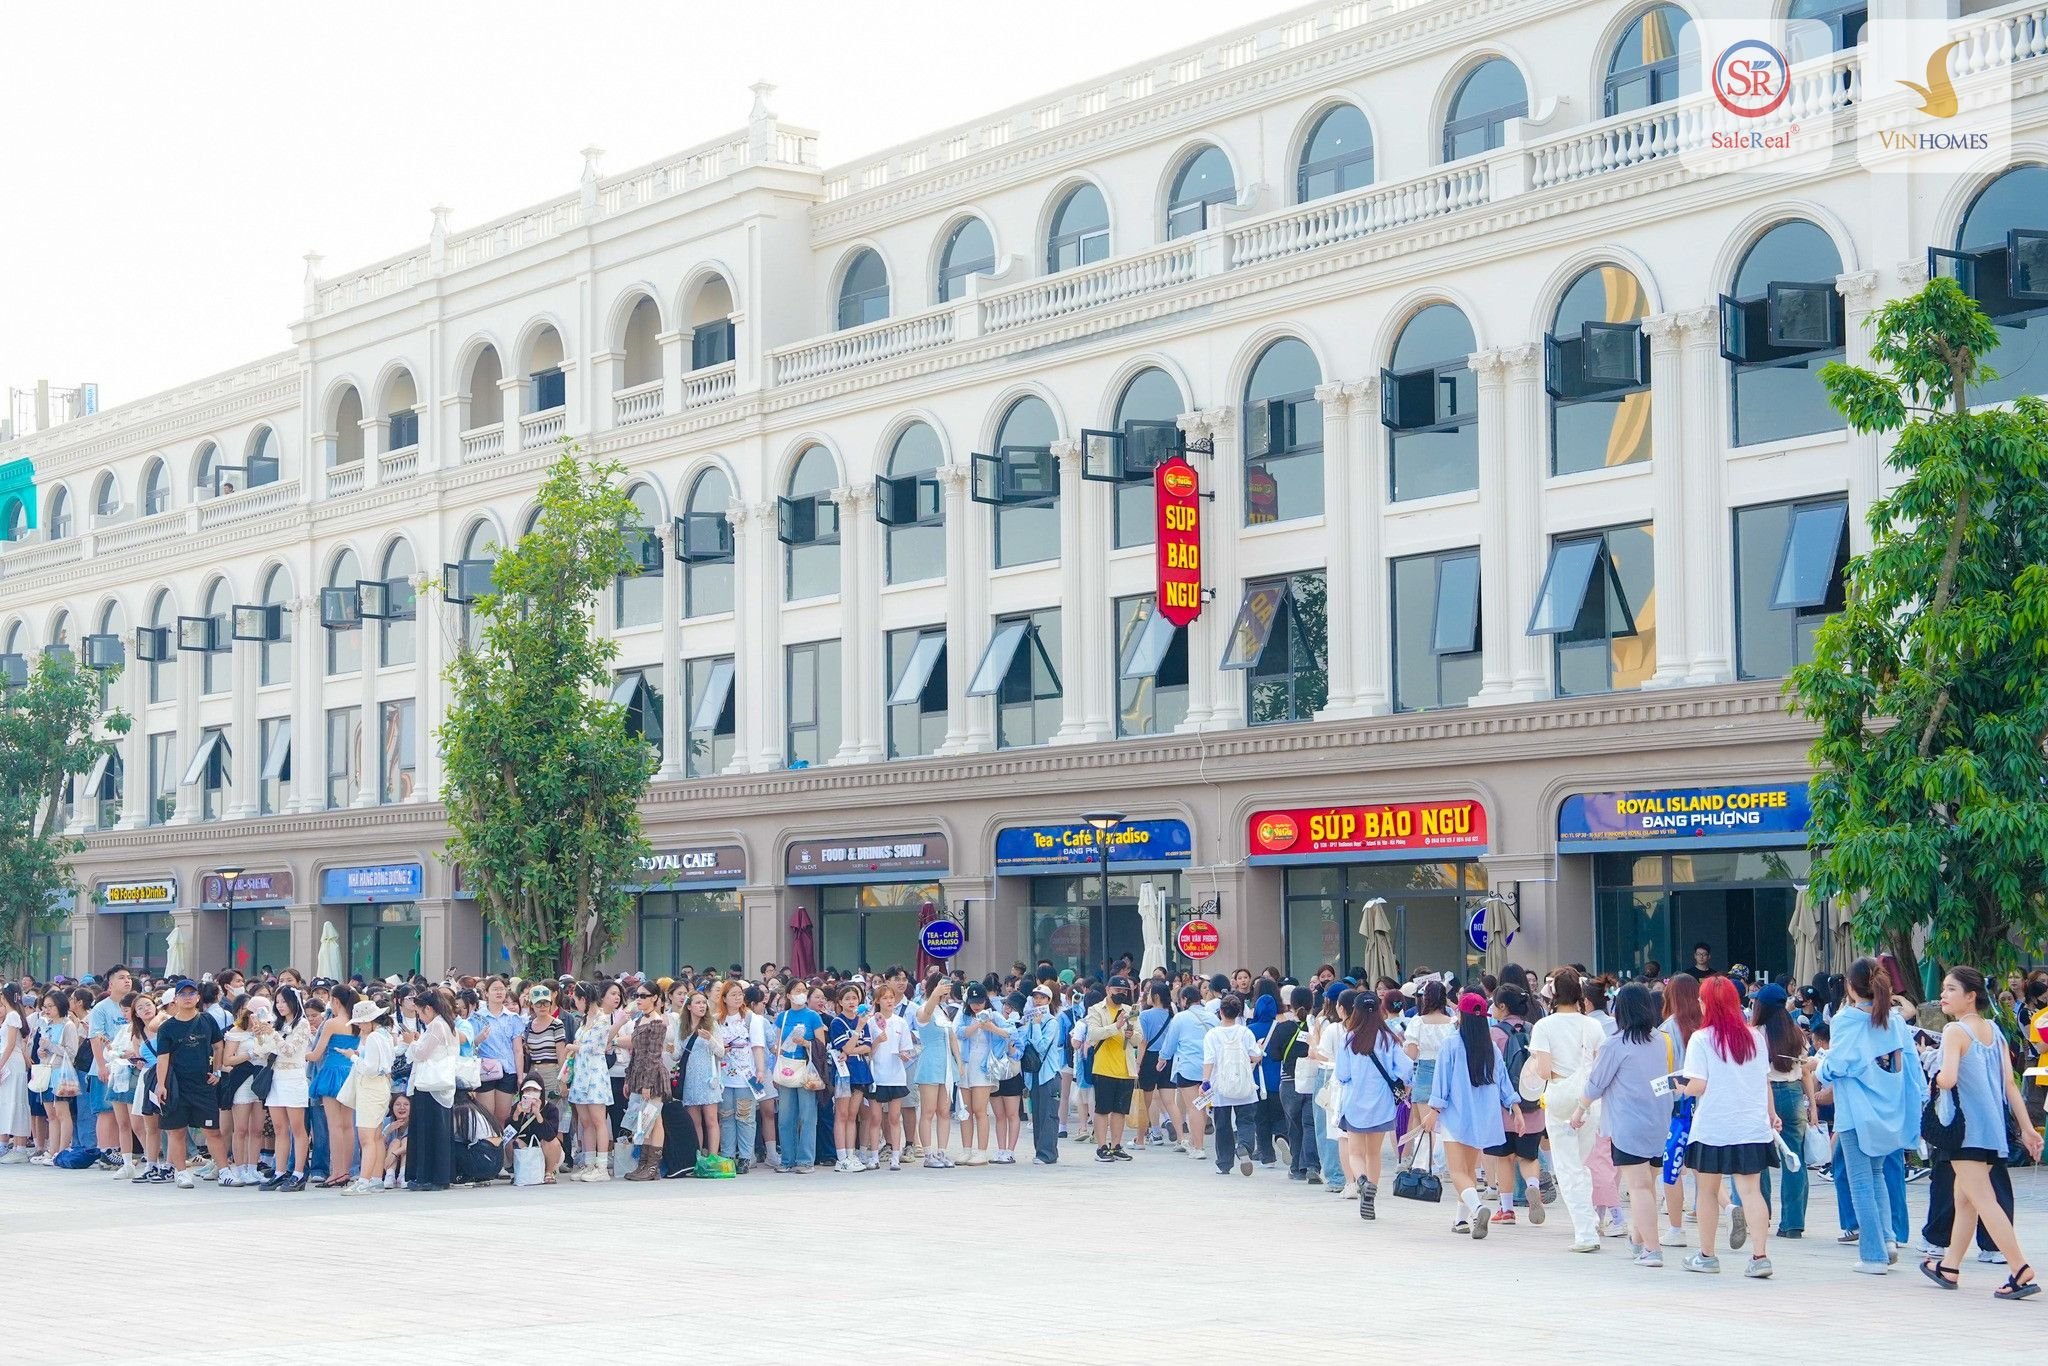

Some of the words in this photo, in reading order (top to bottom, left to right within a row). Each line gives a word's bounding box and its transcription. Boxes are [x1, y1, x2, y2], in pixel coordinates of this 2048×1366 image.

[1165, 500, 1197, 532] SÚP
[1166, 538, 1199, 570] BÀO
[1165, 581, 1200, 608] NGƯ
[1616, 797, 1666, 815] ROYAL
[1667, 794, 1724, 813] ISLAND
[1726, 791, 1788, 810] COFFEE
[1310, 809, 1356, 841] SÚP
[1364, 806, 1411, 838] BÀO
[1420, 805, 1472, 836] NGƯ
[1642, 813, 1688, 828] ĐANG
[1690, 810, 1760, 828] PHƯỢNG
[1033, 832, 1053, 848] Tea
[1063, 829, 1092, 847] Café
[683, 852, 716, 868] CAFE
[821, 847, 847, 862] FOOD
[847, 847, 857, 860] &
[857, 845, 893, 860] DRINKS
[894, 843, 924, 858] SHOW
[145, 886, 167, 898] Drinks
[943, 930, 959, 938] CAFÉ
